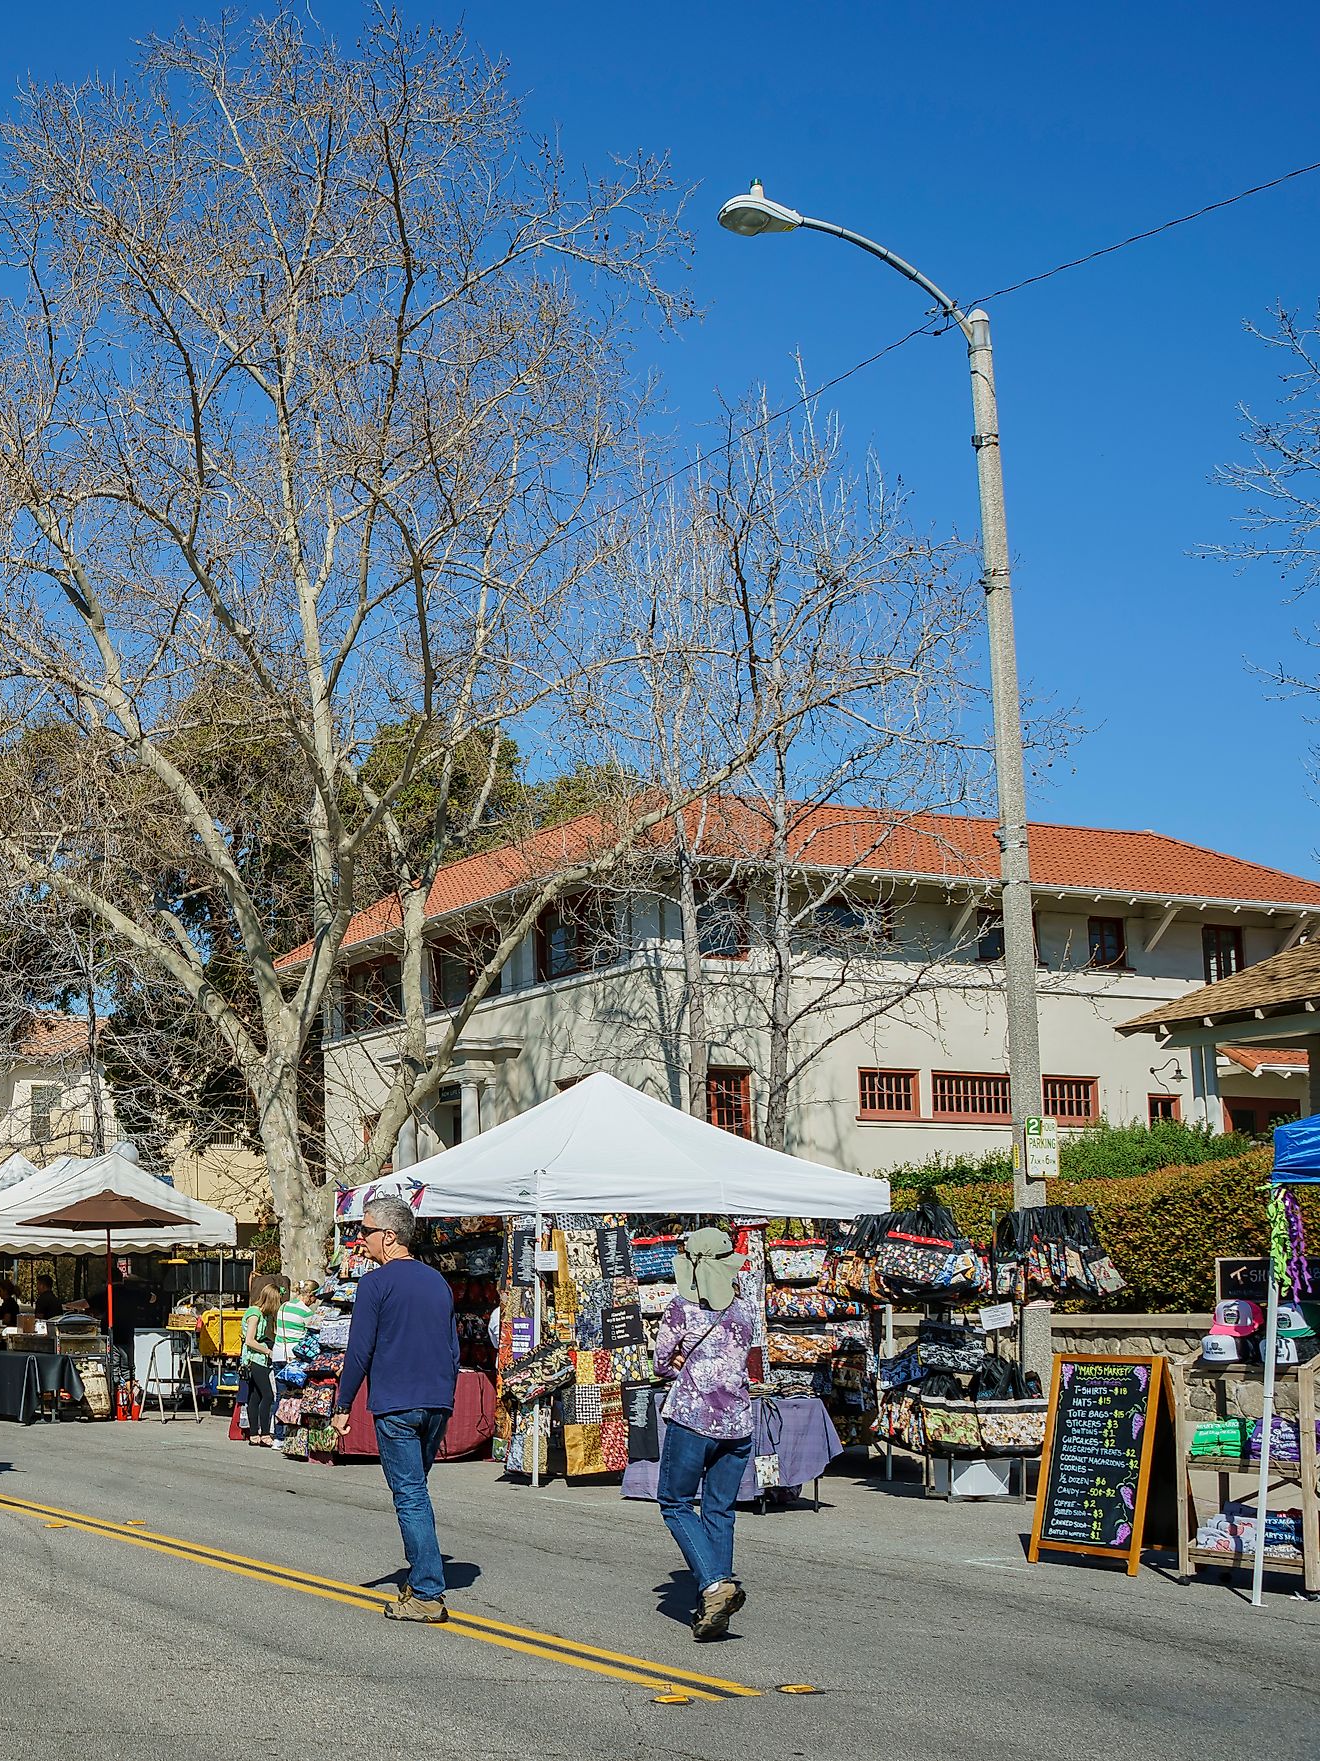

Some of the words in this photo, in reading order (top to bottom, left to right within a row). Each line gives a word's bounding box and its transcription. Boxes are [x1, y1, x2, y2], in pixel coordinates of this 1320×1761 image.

[1028, 1119, 1039, 1134] 2
[1029, 1138, 1056, 1149] PARKING
[1229, 1266, 1269, 1285] T-SH
[1079, 1365, 1102, 1377] MARY'S
[1103, 1365, 1129, 1376] MARKET
[1074, 1386, 1108, 1395] T-SHIRTS
[1113, 1387, 1128, 1396] $18
[1072, 1398, 1092, 1407] HATS
[1098, 1396, 1111, 1405] $15
[1067, 1409, 1087, 1418] TOTE
[1088, 1410, 1109, 1418] BAGS
[1113, 1409, 1125, 1418] $15
[1065, 1419, 1102, 1428] STICKERS
[1106, 1419, 1119, 1429] $3
[1102, 1429, 1116, 1437] $1
[1062, 1436, 1099, 1446] CUPCAKES
[1103, 1439, 1116, 1448] $2
[1100, 1448, 1122, 1456] TREATS
[1126, 1448, 1136, 1457] $2
[1060, 1454, 1088, 1463] COCONUT
[1088, 1457, 1126, 1468] MACAROONS
[1129, 1459, 1139, 1470] $2
[1060, 1463, 1087, 1473] COOKIES
[1068, 1476, 1089, 1485] DOZEN
[1095, 1477, 1107, 1486] $6
[1057, 1486, 1079, 1497] CANDY
[1054, 1499, 1077, 1508] COFFEE
[1083, 1500, 1096, 1509] $2
[1073, 1509, 1086, 1517] SODA
[1092, 1509, 1104, 1519] $3
[1051, 1518, 1073, 1527] CANNED
[1091, 1521, 1102, 1531] $1
[1089, 1531, 1100, 1540] $1
